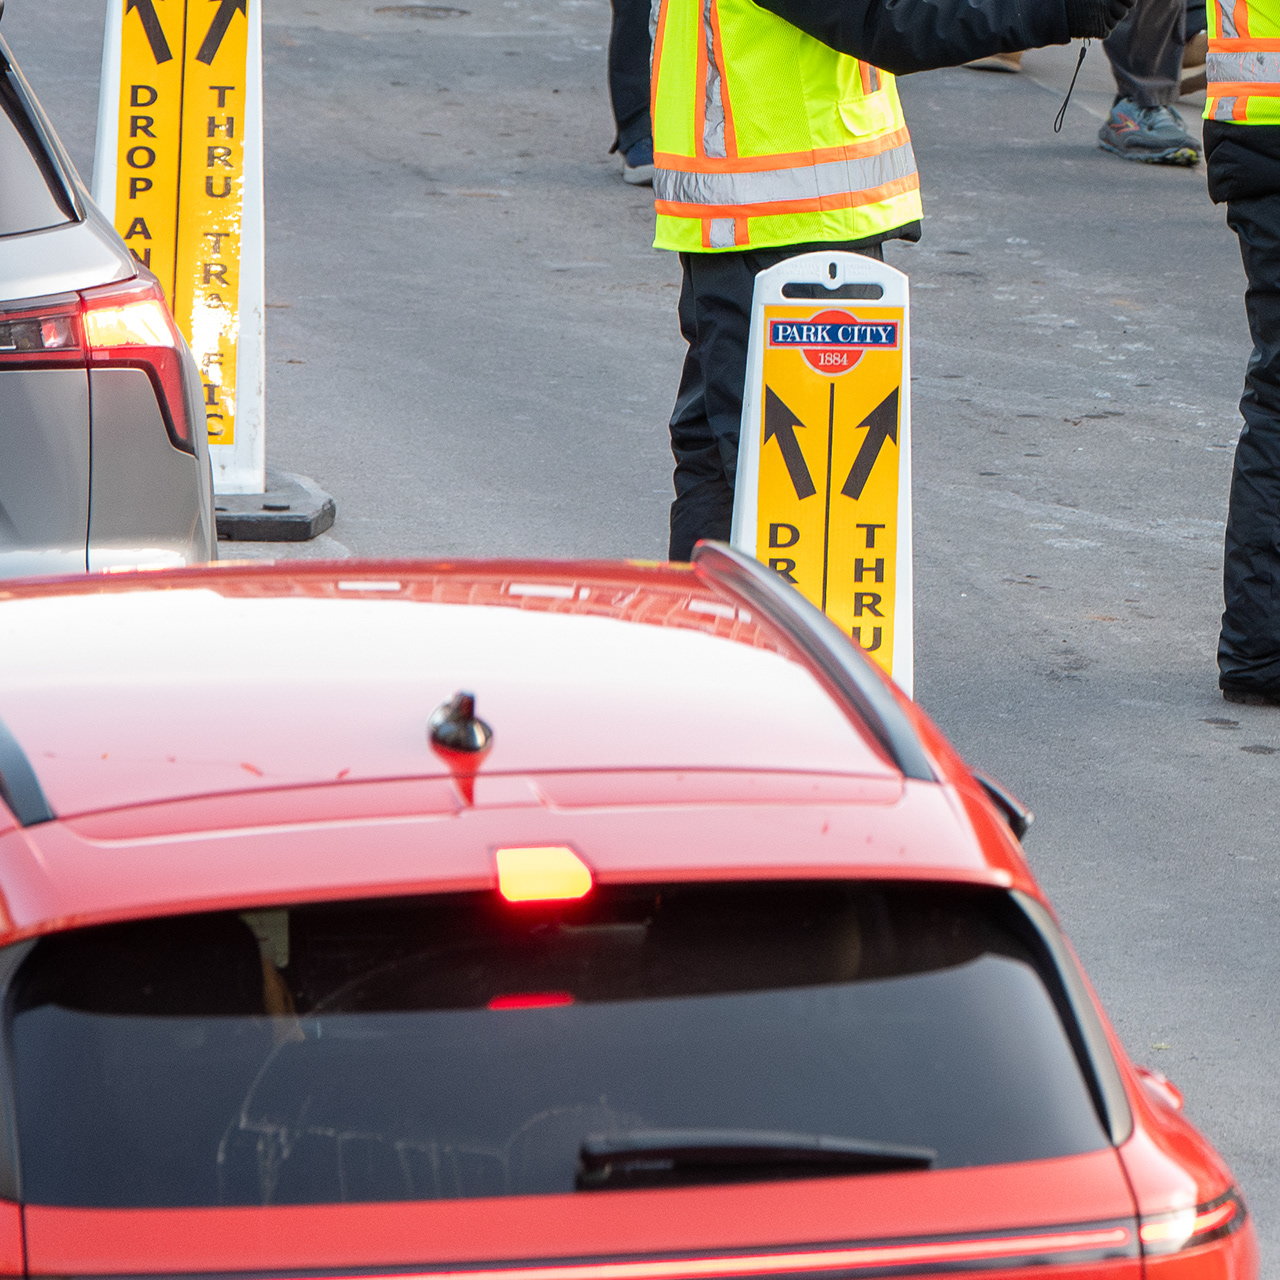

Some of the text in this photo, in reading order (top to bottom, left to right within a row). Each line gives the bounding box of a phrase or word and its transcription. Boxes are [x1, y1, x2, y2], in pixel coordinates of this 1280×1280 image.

[126, 84, 159, 200] DROP
[205, 85, 236, 199] THRU
[775, 323, 892, 343] PARK CITY
[818, 353, 848, 367] 1884
[851, 522, 886, 652] THRU
